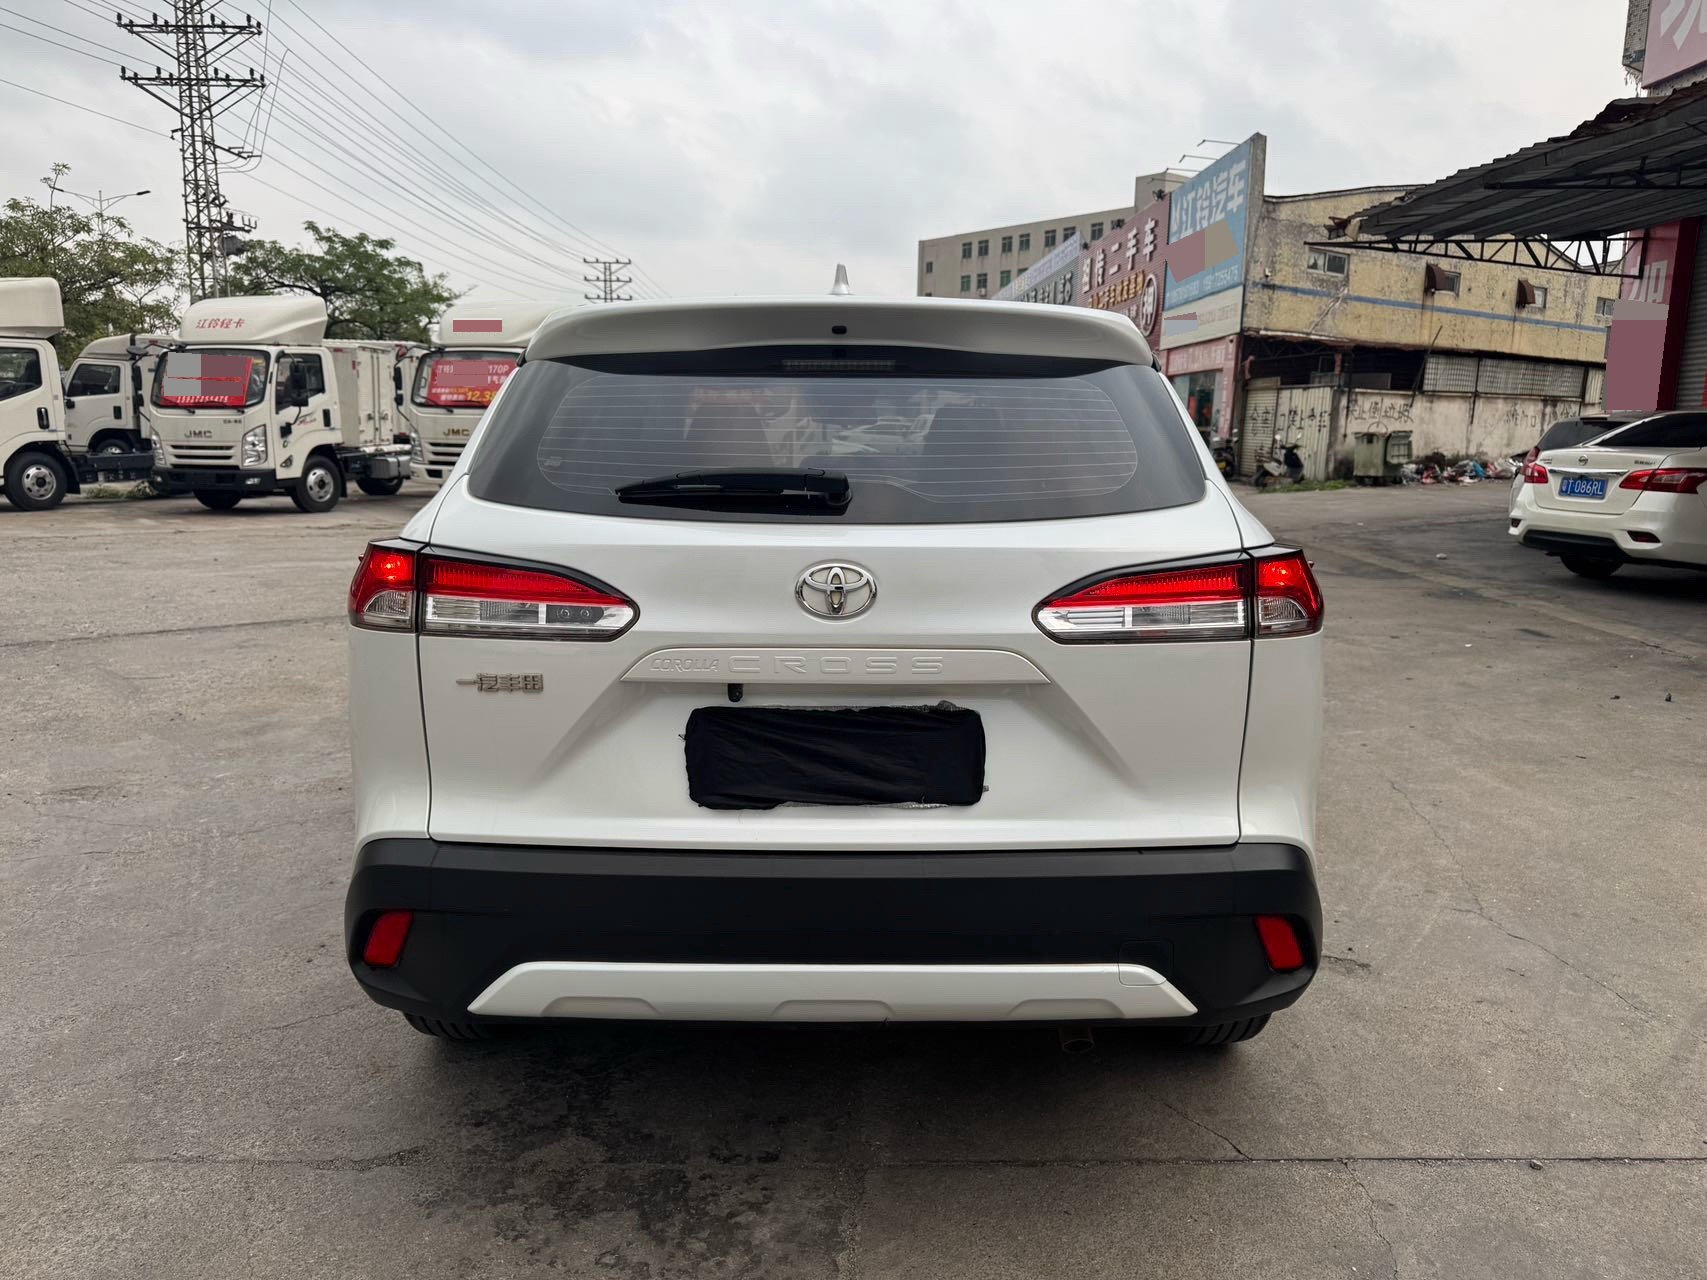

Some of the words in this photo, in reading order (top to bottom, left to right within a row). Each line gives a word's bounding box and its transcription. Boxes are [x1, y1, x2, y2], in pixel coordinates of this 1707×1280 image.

[195, 318, 245, 329] 江铃轻卡
[184, 430, 212, 438] JMC
[443, 428, 470, 437] JMC
[651, 658, 720, 672] COROLLA
[728, 656, 944, 674] CROSS
[456, 673, 544, 692] 一汽丰田
